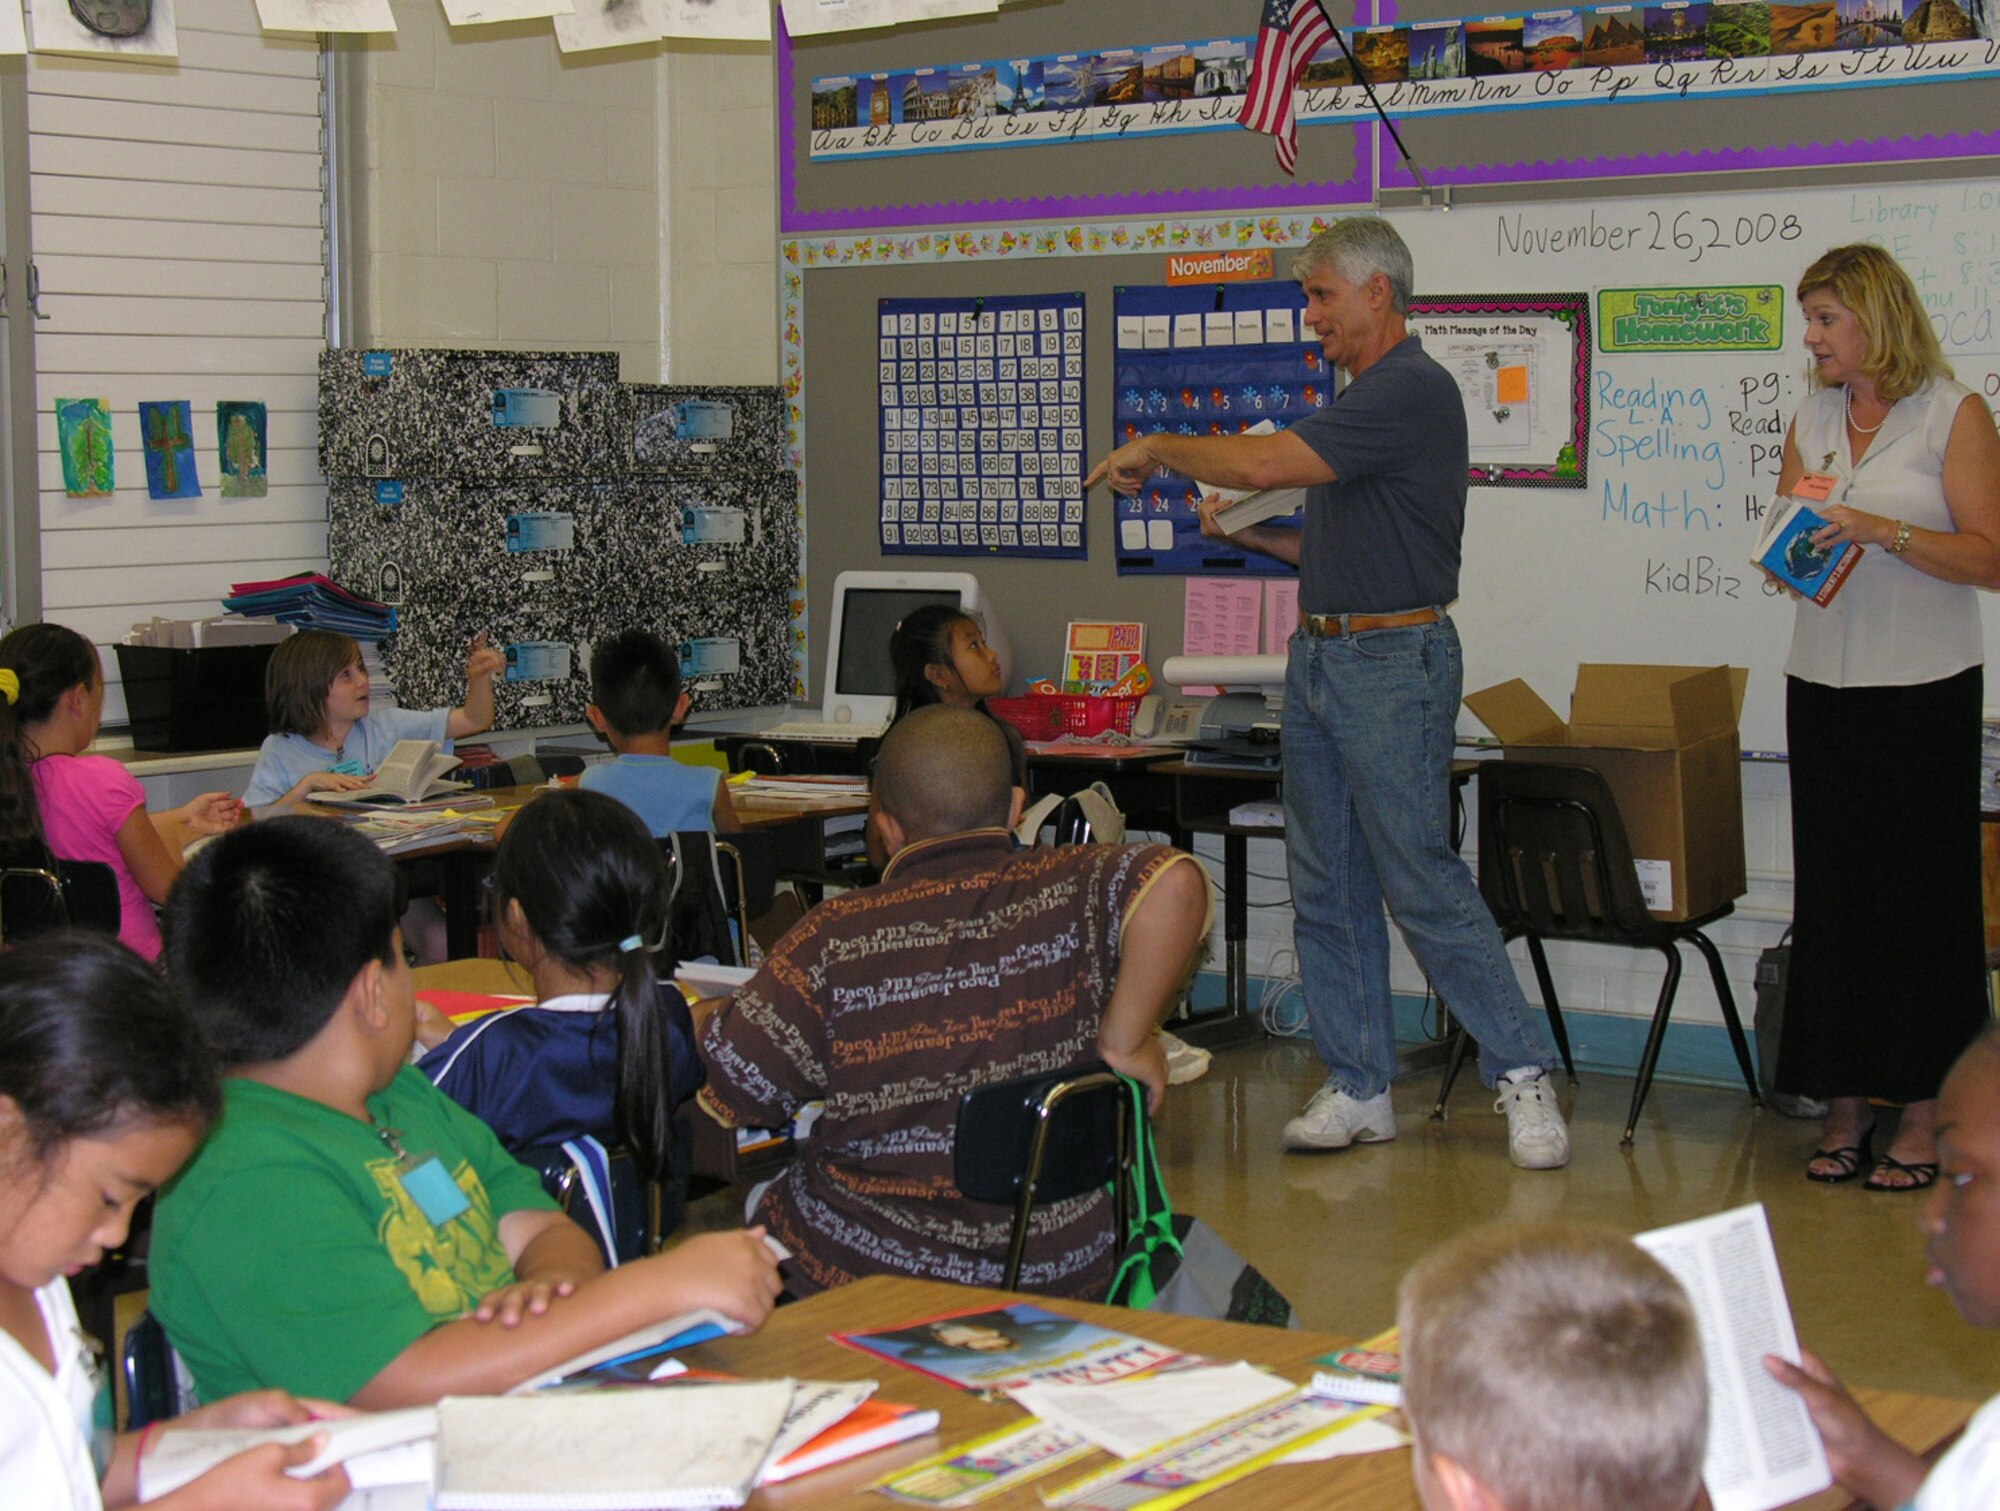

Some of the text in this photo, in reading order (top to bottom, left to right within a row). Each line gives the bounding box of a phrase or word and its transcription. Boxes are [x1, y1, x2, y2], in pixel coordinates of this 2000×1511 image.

[1850, 194, 1939, 233] Library
[1498, 210, 1641, 255] November
[1171, 254, 1251, 276] November
[887, 312, 1080, 331] 1 2 3 4 5 6 7 8 9 10
[1615, 315, 1769, 345] Homework
[1425, 325, 1537, 337] Math Message of the Day
[883, 336, 1081, 355] 11 12 13 14 15 16 17 18 19 20
[882, 360, 1081, 380] 21 22 23 24 25 26 27 28 29 30
[1317, 359, 1324, 372] 1
[1137, 393, 1323, 412] 2 3 4 5 6 7 8
[887, 408, 1078, 425] 41 42 43 44 45 46 47 48 49 50
[885, 456, 1078, 472] 61 62 63 64 65 66 67 68 69 70
[888, 480, 1080, 496] 71 72 73 74 75 76 77 78 79 80
[1130, 500, 1142, 513] 23
[1155, 499, 1169, 512] 24
[885, 526, 1078, 543] 91 92 93 94 95 96 97 98 99 100
[1645, 556, 1741, 599] KidBiz
[960, 975, 1000, 989] Paco
[833, 984, 874, 1001] Paco
